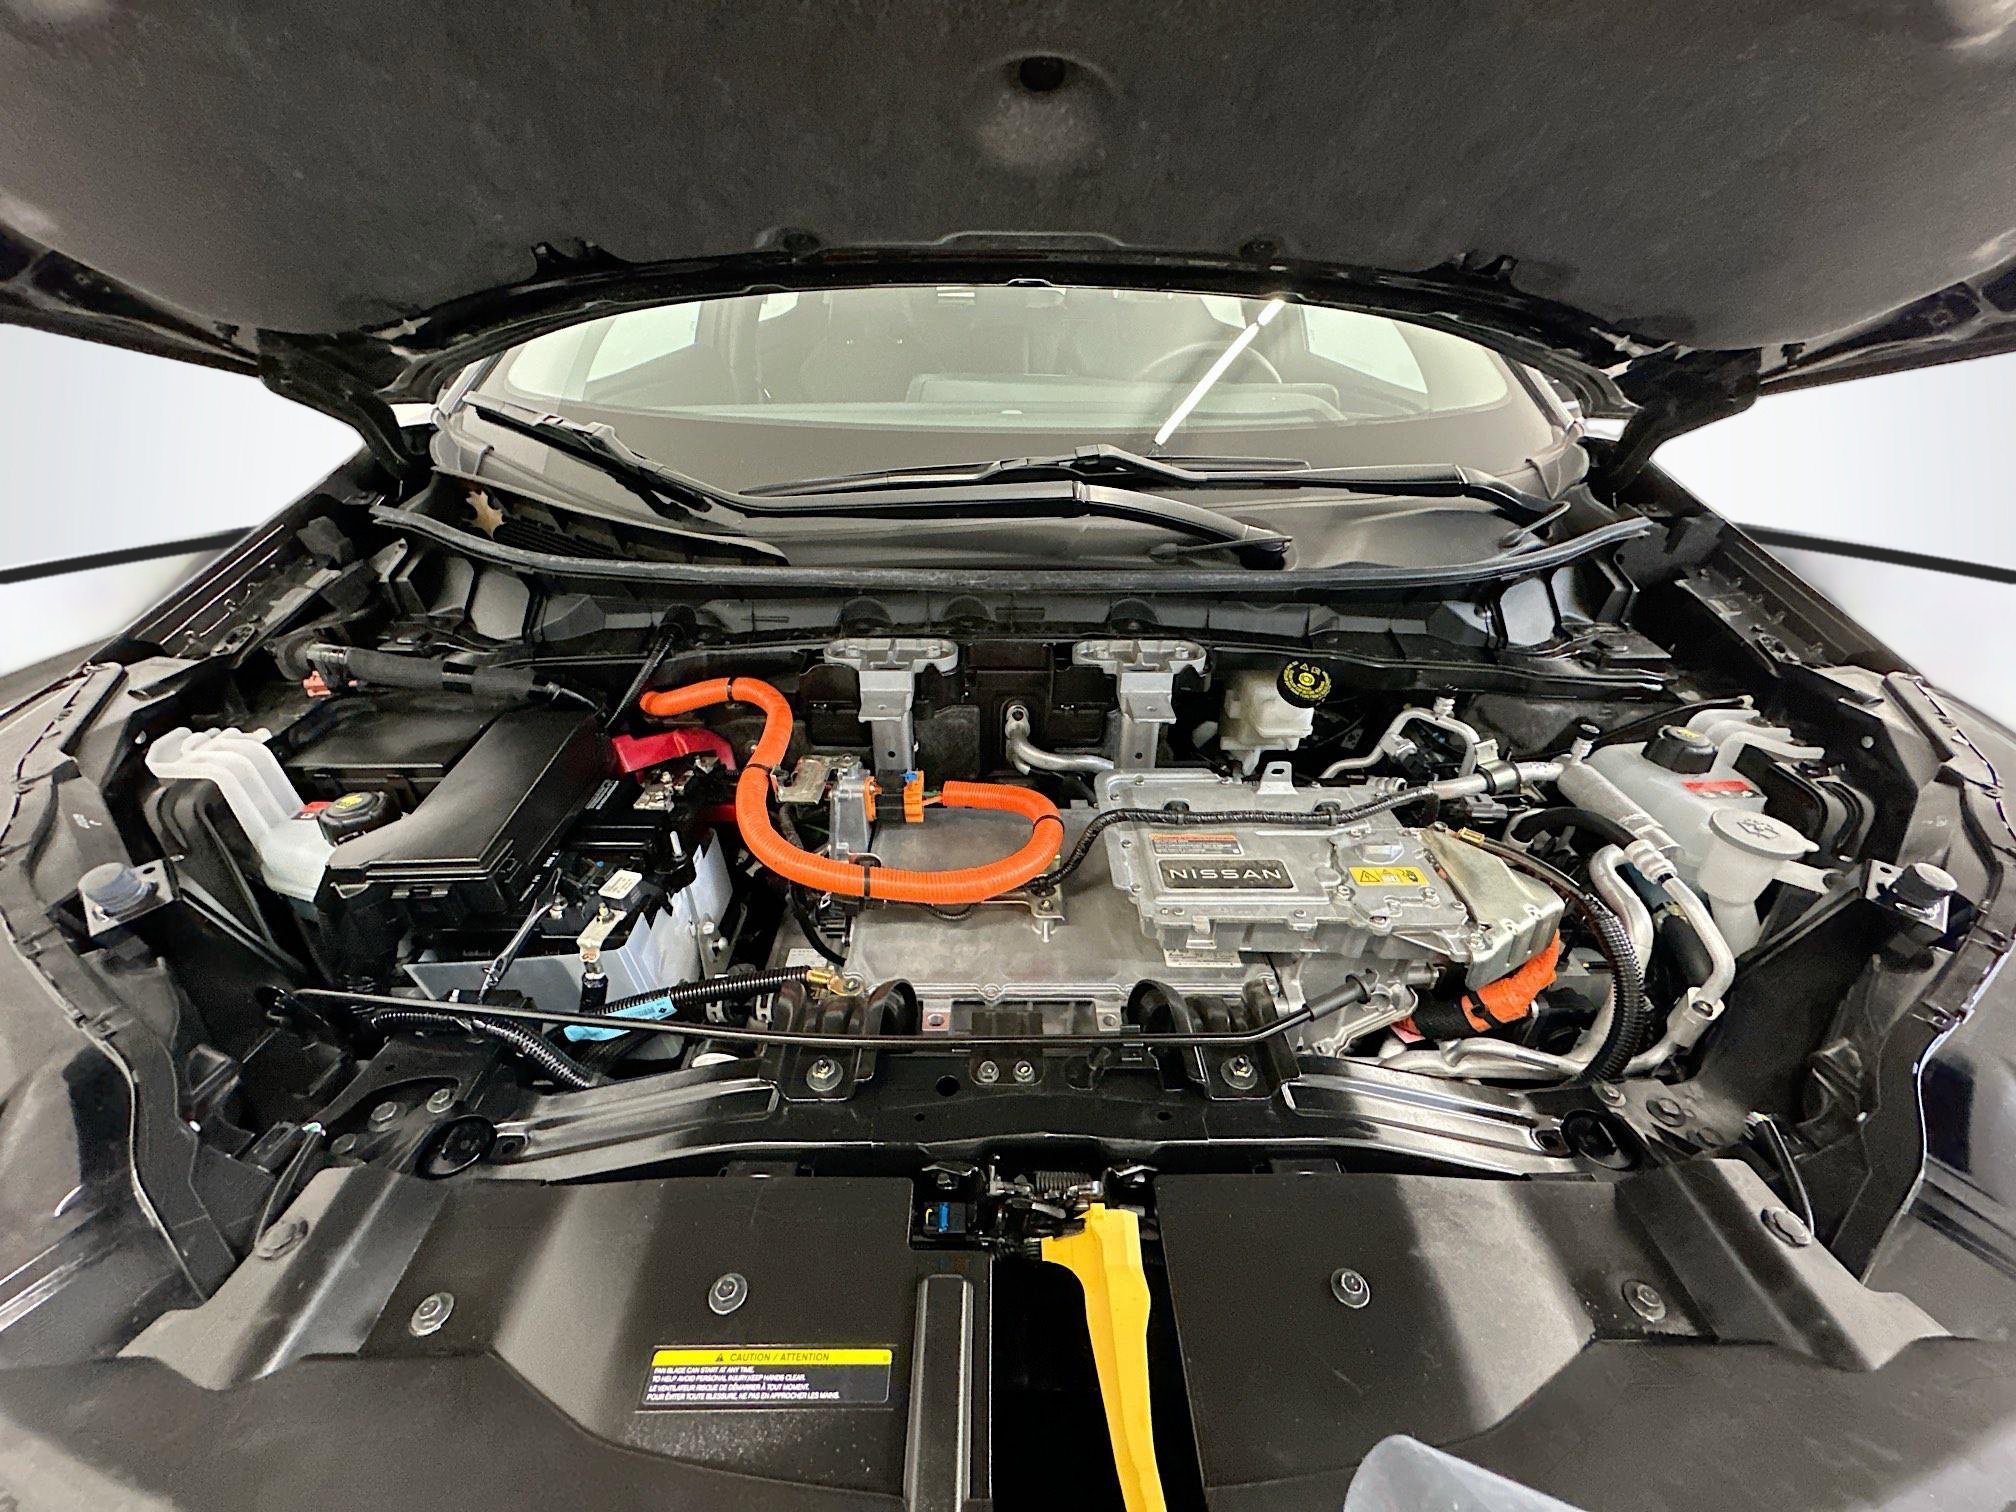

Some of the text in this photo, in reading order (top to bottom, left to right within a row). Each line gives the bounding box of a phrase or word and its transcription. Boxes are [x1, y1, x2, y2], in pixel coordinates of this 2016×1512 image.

[1169, 869, 1281, 880] NISSAN
[730, 1353, 770, 1362] CAUTION
[780, 1352, 829, 1361] ATTENTION
[763, 1374, 784, 1382] HANDS
[658, 1384, 695, 1392] VENTILATEUR
[719, 1384, 727, 1392] DE
[767, 1383, 783, 1391] TOUT
[646, 1393, 665, 1401] POUR
[686, 1393, 705, 1401] TOUTE
[770, 1392, 808, 1400] APPROCHER
[808, 1392, 819, 1400] LES
